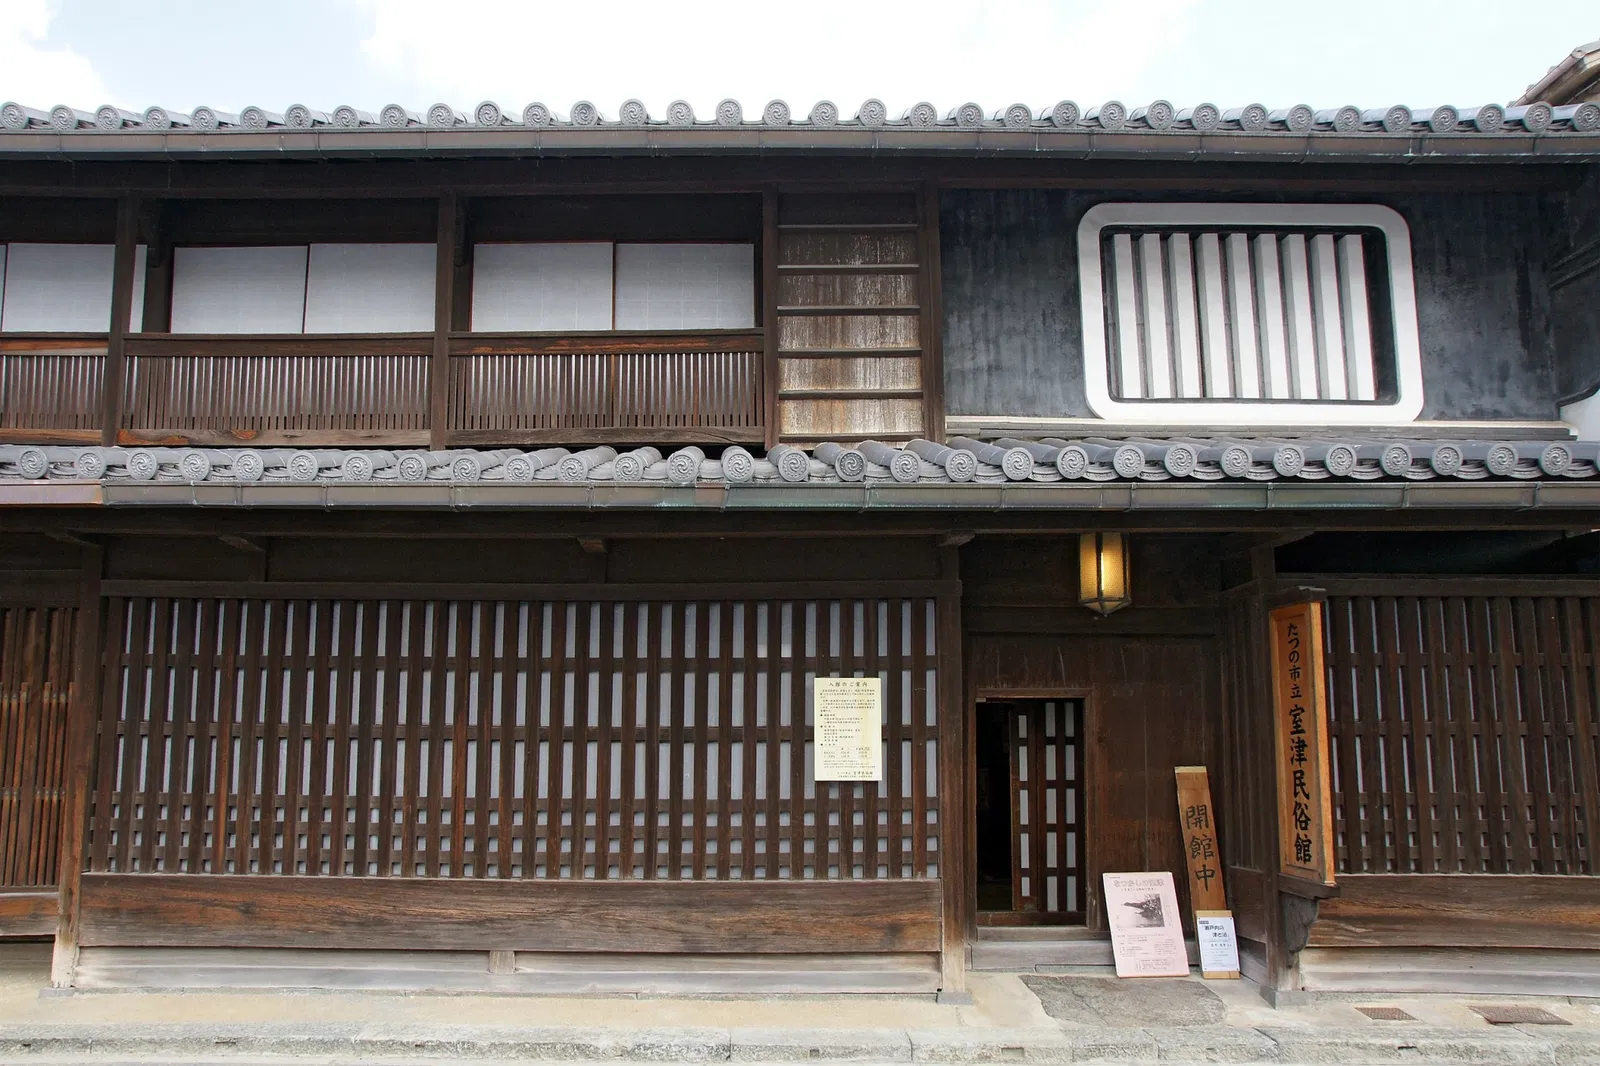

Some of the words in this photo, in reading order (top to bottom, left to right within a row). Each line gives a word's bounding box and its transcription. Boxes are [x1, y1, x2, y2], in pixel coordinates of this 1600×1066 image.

[1286, 622, 1303, 700] たつの市立
[1288, 704, 1313, 865] 室津民俗館
[1185, 804, 1216, 891] 開館中
